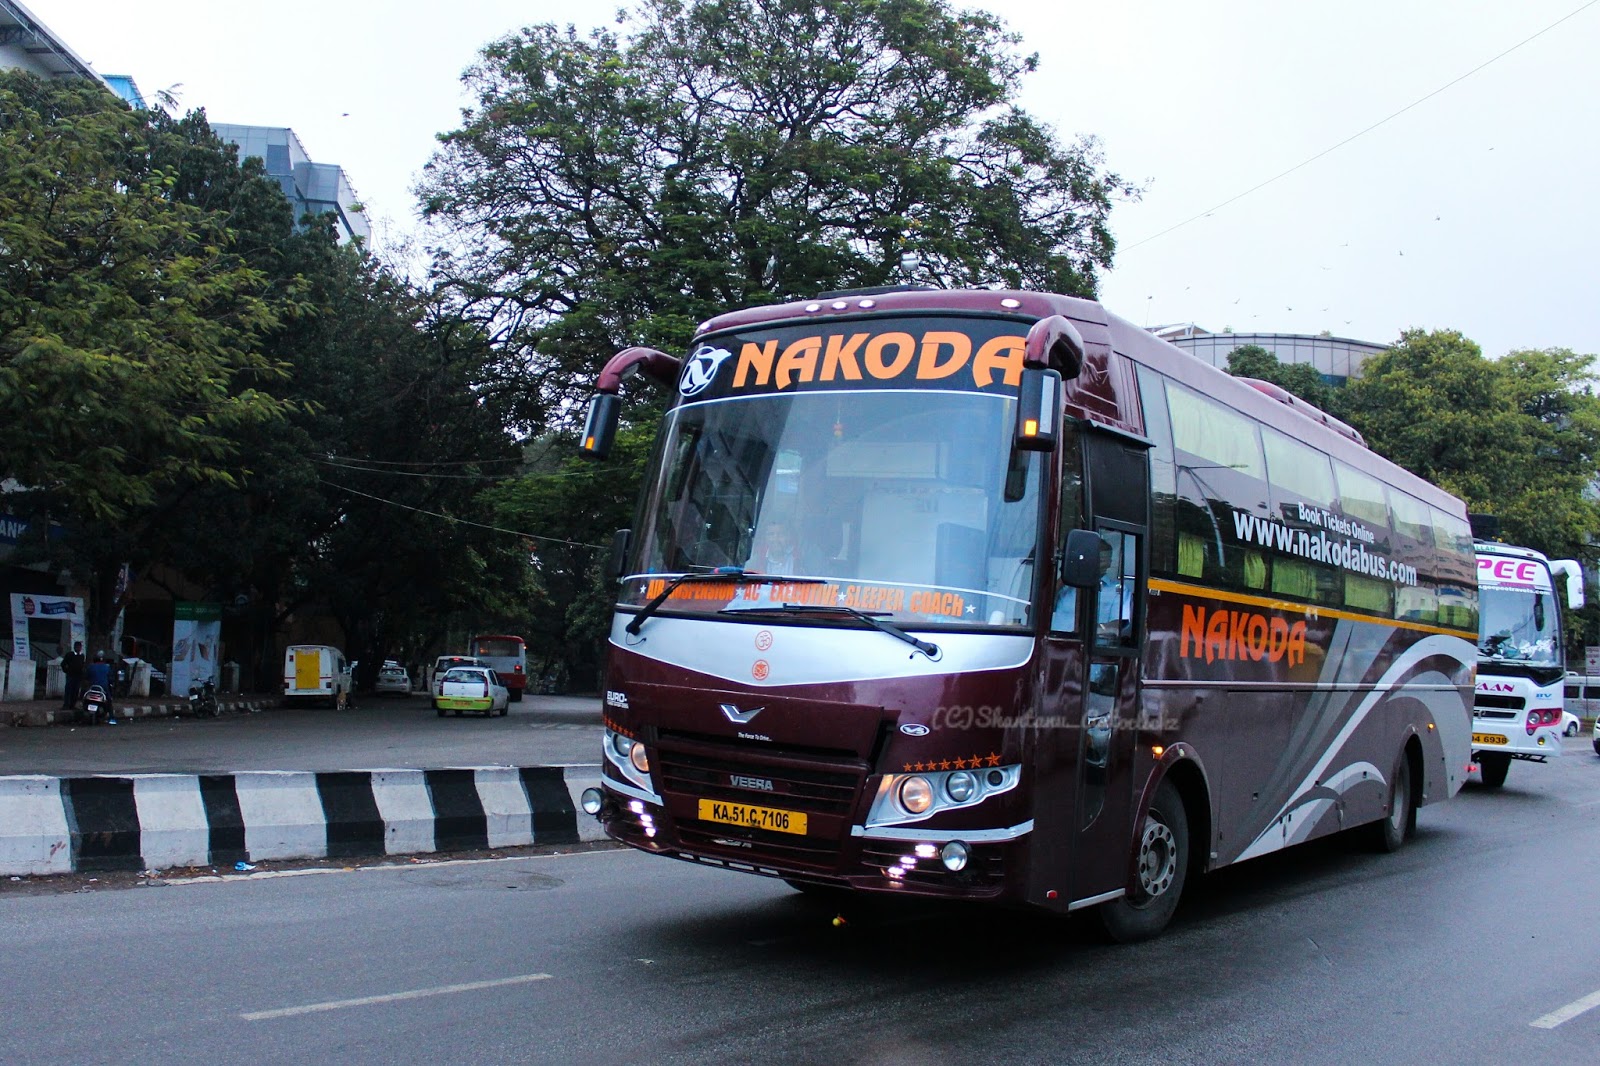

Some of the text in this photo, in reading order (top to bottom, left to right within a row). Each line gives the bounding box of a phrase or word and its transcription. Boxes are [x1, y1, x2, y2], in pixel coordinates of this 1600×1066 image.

[732, 331, 1027, 390] NAKODA
[1298, 501, 1375, 544] Book Tickets Online
[1233, 511, 1417, 586] www.nakodabus.com
[743, 582, 761, 602] AC
[769, 582, 840, 606] EXECUTIVE
[844, 585, 905, 611] SLEEPER
[909, 591, 965, 617] COACH
[1180, 604, 1306, 669] NAKODA
[730, 775, 773, 790] VEERA
[713, 803, 789, 829] KA.51.C.7106
